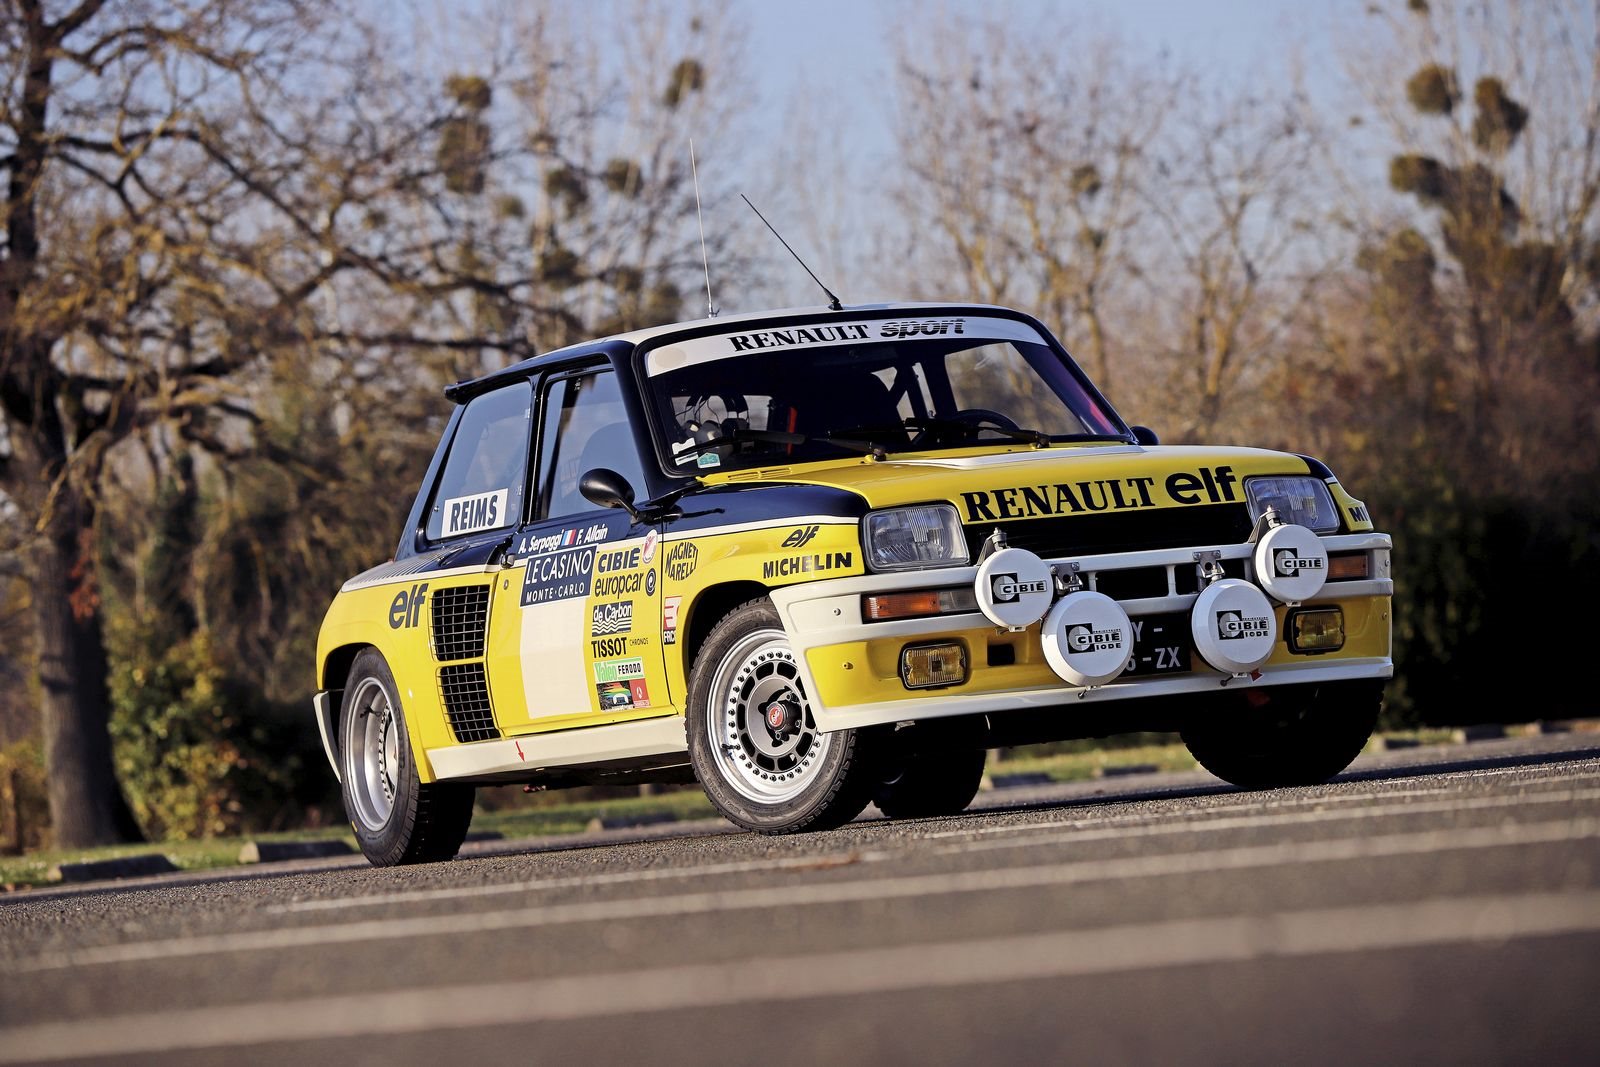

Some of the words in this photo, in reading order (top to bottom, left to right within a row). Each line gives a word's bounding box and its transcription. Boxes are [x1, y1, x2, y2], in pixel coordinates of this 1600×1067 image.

[727, 324, 871, 352] RENAULT
[880, 318, 966, 338] sport
[960, 477, 1156, 522] RENAULT
[1165, 466, 1237, 504] elf
[449, 495, 498, 532] REIMS
[518, 538, 527, 554] A.
[528, 528, 564, 554] Serpaggi
[576, 529, 584, 545] F.
[584, 524, 608, 543] Allain
[781, 526, 819, 548] elf
[525, 557, 540, 584] LE
[541, 549, 592, 582] CASINO
[763, 552, 852, 579] MICHELIN
[595, 573, 644, 599] europcar
[389, 583, 429, 629] elf
[593, 606, 603, 622] de
[605, 603, 632, 622] Carbon
[591, 637, 627, 658] TISSOT
[594, 661, 618, 682] Valeo
[618, 662, 641, 675] FERODO
